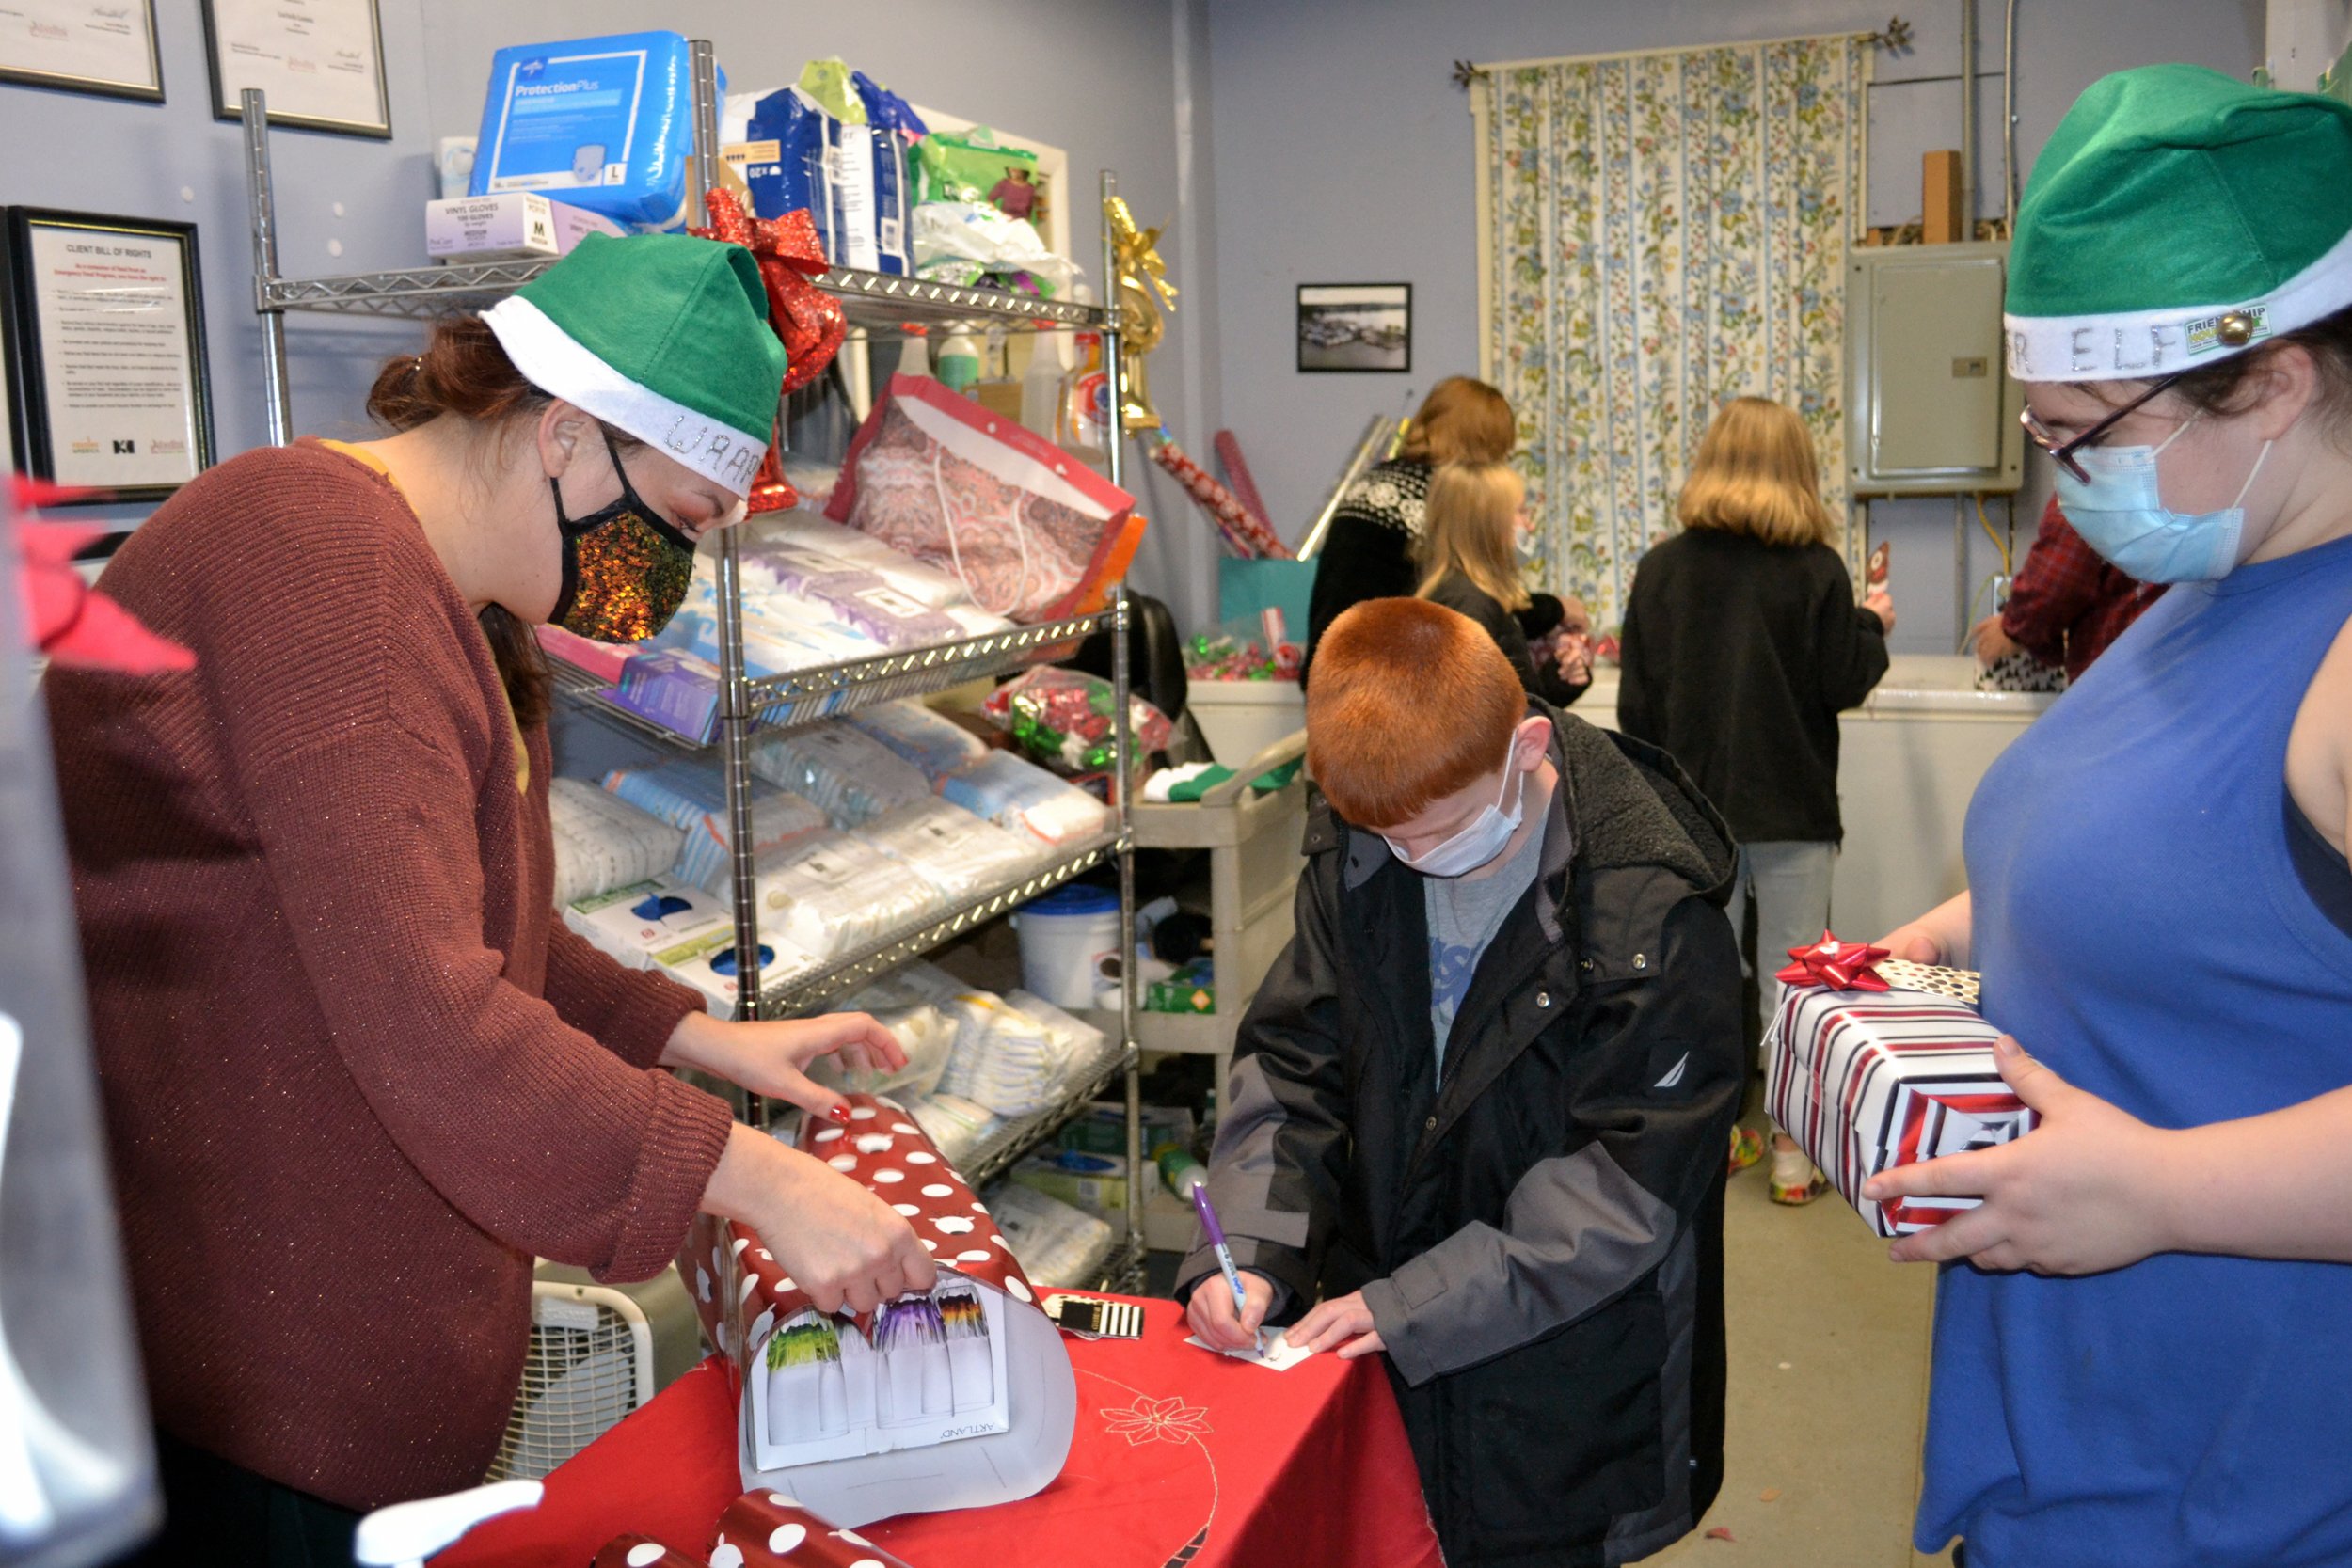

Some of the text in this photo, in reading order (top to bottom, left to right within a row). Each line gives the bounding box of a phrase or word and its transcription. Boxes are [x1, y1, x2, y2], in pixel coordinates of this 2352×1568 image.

[612, 166, 619, 179] L
[469, 203, 499, 213] GLOVES
[534, 221, 545, 236] M
[66, 244, 93, 254] CLIENT
[95, 246, 112, 256] BILL
[125, 249, 152, 259] RIGHTS
[2187, 307, 2266, 334] FRIEHIP
[2072, 323, 2183, 372] ELF
[663, 415, 762, 483] WRAP
[942, 1421, 995, 1439] ARTLAND
